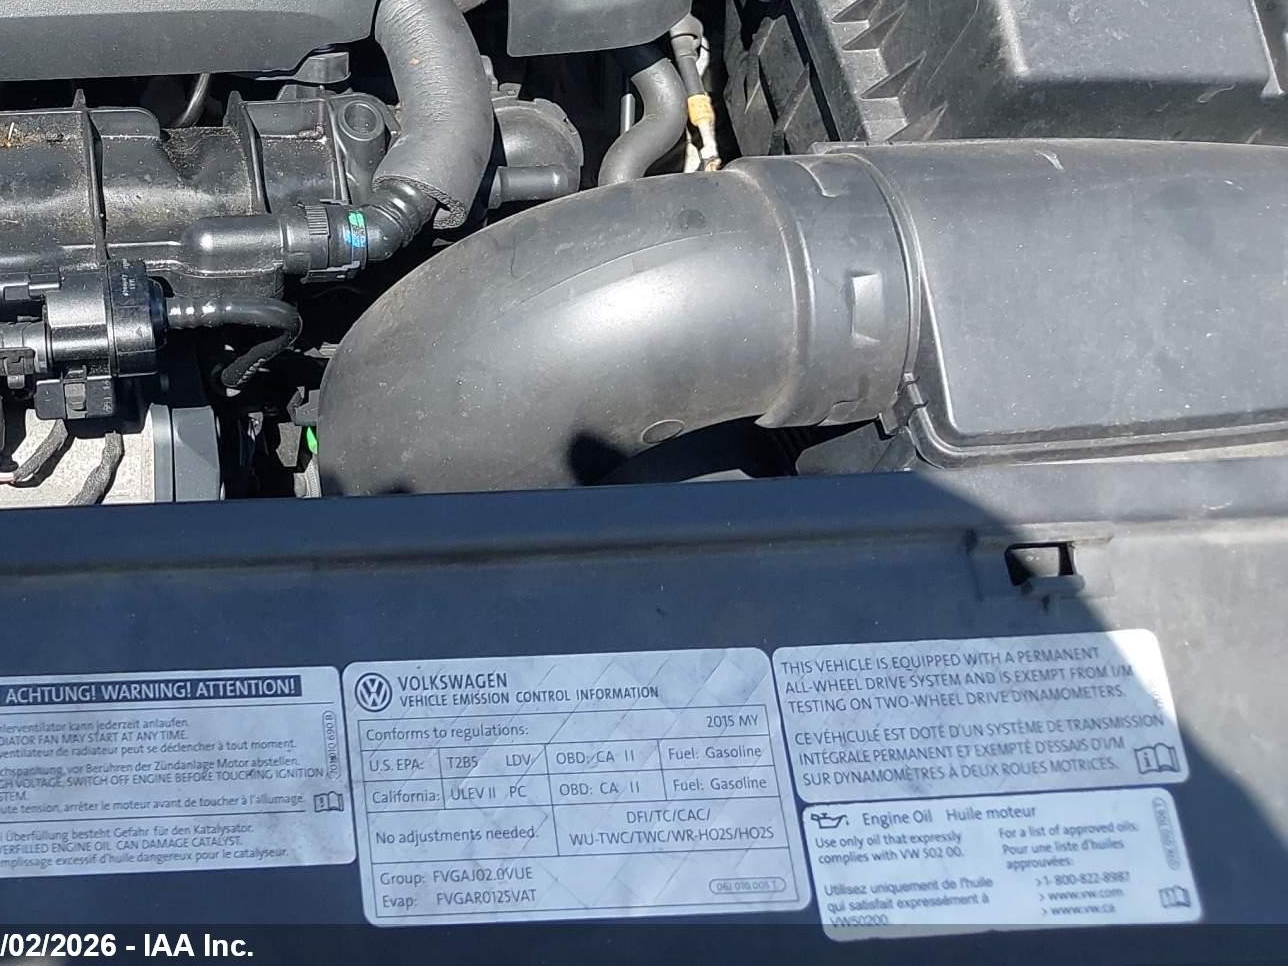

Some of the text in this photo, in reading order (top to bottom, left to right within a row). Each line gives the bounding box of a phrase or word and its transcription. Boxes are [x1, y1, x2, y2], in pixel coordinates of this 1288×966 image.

[782, 647, 1100, 674] THIS VEHICLE IS EQUIPPED WITH A PERMANENT
[398, 672, 508, 692] VOLKSWAGEN
[786, 666, 1107, 694] ALL-WHEEL DRIVE SYSTEM AND IS EXEMPT FROM
[5, 678, 295, 703] ACHTUNG! WARNING! ATTENTION!
[400, 686, 659, 708] VEHICLE EMISSION CONTROL INFORMATION
[788, 685, 1126, 714] TESTING ON TWO-WHEEL DRIVE DYNAMOMETERS.
[707, 714, 758, 728] 2015 MY
[794, 733, 812, 746] CE
[884, 728, 906, 741] EST
[1047, 720, 1062, 733] DE
[1066, 714, 1164, 731] TRANSMISSION
[39, 736, 58, 745] FAN
[62, 734, 86, 744] MAY
[87, 733, 118, 744] START
[121, 732, 134, 742] AT
[136, 732, 160, 741] ANY
[366, 724, 529, 742] Conforms to regulations:
[447, 754, 532, 769] T2B5 LDV
[556, 750, 615, 764] OBD: CA
[668, 746, 762, 760] Fuel: Gasoline
[873, 746, 952, 762] PERMANENT
[958, 745, 970, 758] ET
[217, 758, 249, 769] Motor
[370, 758, 424, 772] U.S. EPA:
[67, 776, 108, 787] SWITCH
[110, 774, 130, 785] OFF
[133, 773, 172, 784] ENGINE
[175, 772, 214, 783] BEFORE
[275, 768, 324, 779] IGNITION
[803, 772, 830, 786] SUR
[963, 764, 1000, 778] DEUX
[1002, 761, 1048, 776] ROUES
[450, 785, 527, 801] ULEV PC
[560, 782, 618, 796] OBD: CA
[674, 776, 768, 792] Fuel: Gasoline
[372, 791, 441, 804] California:
[626, 808, 711, 824] DFI/TC/CAC/
[863, 806, 1036, 829] Engine Oil Huile moteur
[52, 842, 93, 853] ENGINE
[94, 841, 112, 851] OIL
[116, 840, 138, 850] CAN
[142, 838, 188, 850] DAMAGE
[376, 826, 539, 847] No adjustments needed.
[816, 831, 962, 849] Use only oil that expressly
[818, 851, 870, 866] complies
[872, 849, 898, 861] with
[901, 848, 920, 860] VW
[924, 847, 943, 859] 502
[380, 866, 533, 888] Group: FVGAJ02.0VUE
[382, 888, 537, 912] Evap: FVGAR0125VAT
